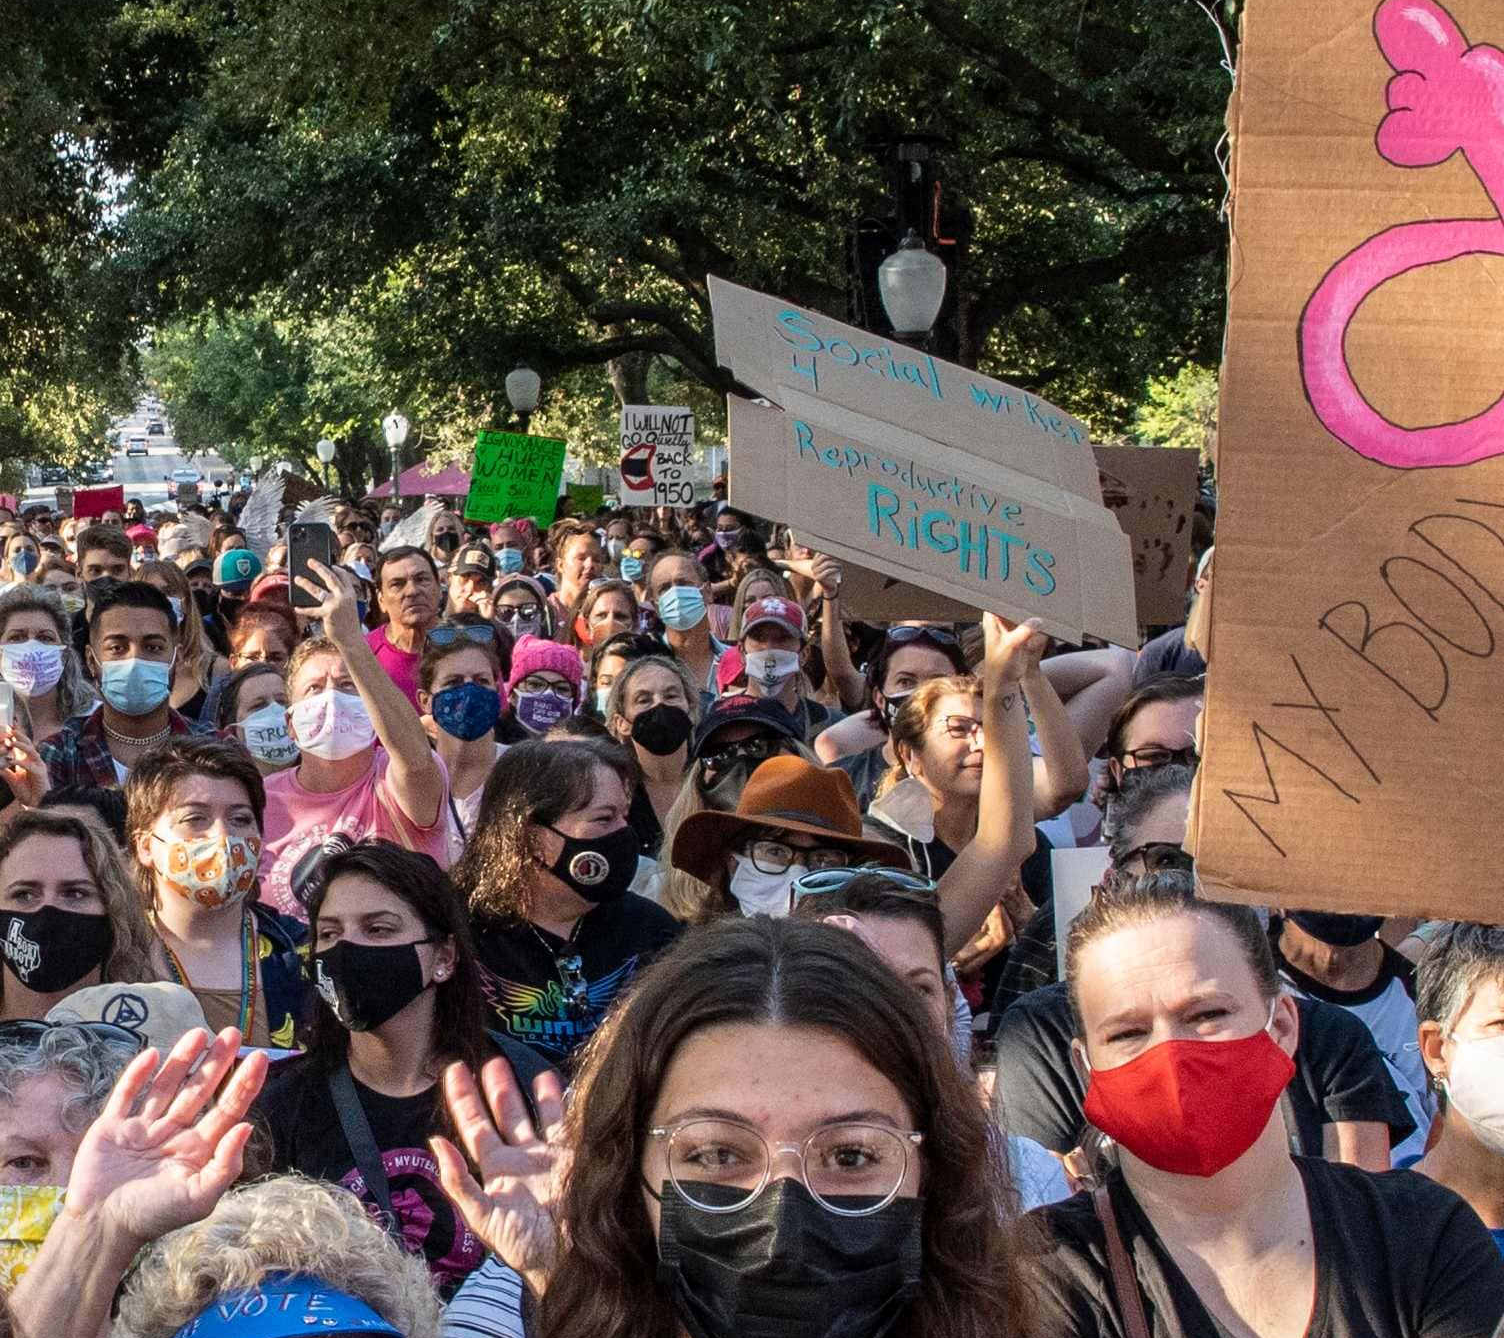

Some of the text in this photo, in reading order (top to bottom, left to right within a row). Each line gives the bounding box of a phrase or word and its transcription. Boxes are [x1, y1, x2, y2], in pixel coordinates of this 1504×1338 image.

[773, 309, 944, 400] Social
[660, 413, 694, 434] NOT
[621, 432, 642, 450] GO
[656, 452, 693, 467] BACK
[658, 468, 682, 480] TO
[793, 420, 1025, 527] Reproductive
[654, 481, 694, 505] 1950
[1221, 658, 1382, 858] MY
[216, 1292, 335, 1322] VOTE
